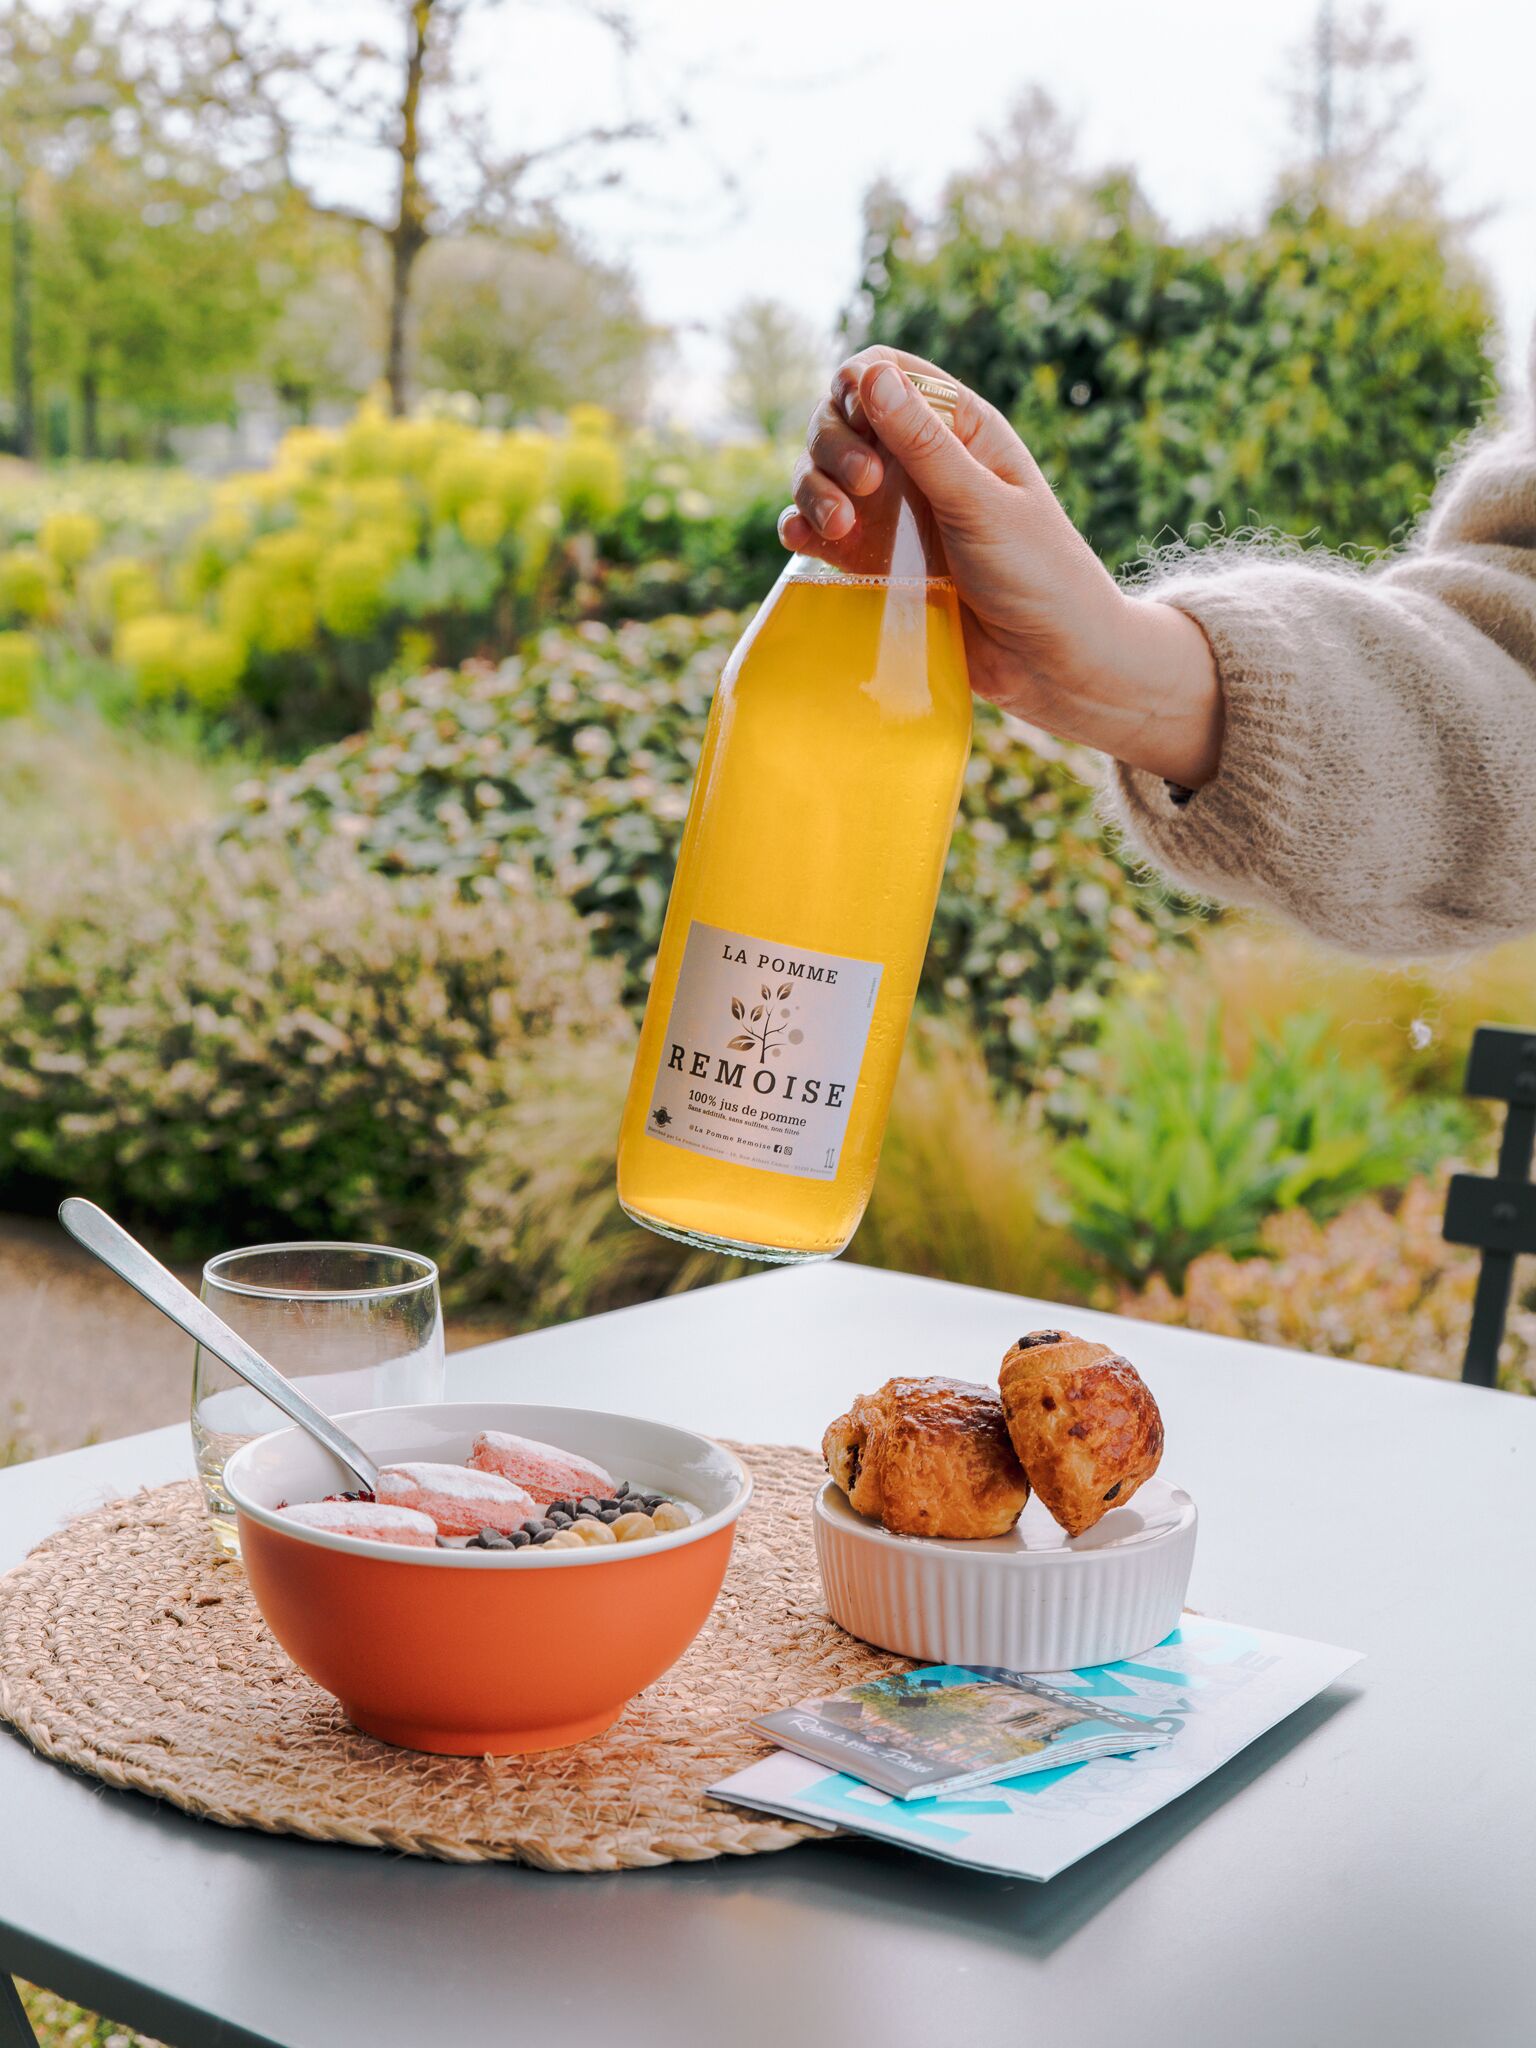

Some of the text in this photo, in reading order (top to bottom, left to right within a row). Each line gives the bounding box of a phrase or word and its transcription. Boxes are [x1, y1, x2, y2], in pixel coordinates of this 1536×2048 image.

[722, 945, 838, 984] LA POMME
[667, 1044, 845, 1108] REMOISE
[687, 1104, 702, 1113] Sans
[728, 1116, 743, 1124] sans
[688, 1089, 807, 1127] 100% jus de pomme
[705, 1129, 734, 1142] Pomme
[736, 1137, 771, 1150] Remoise
